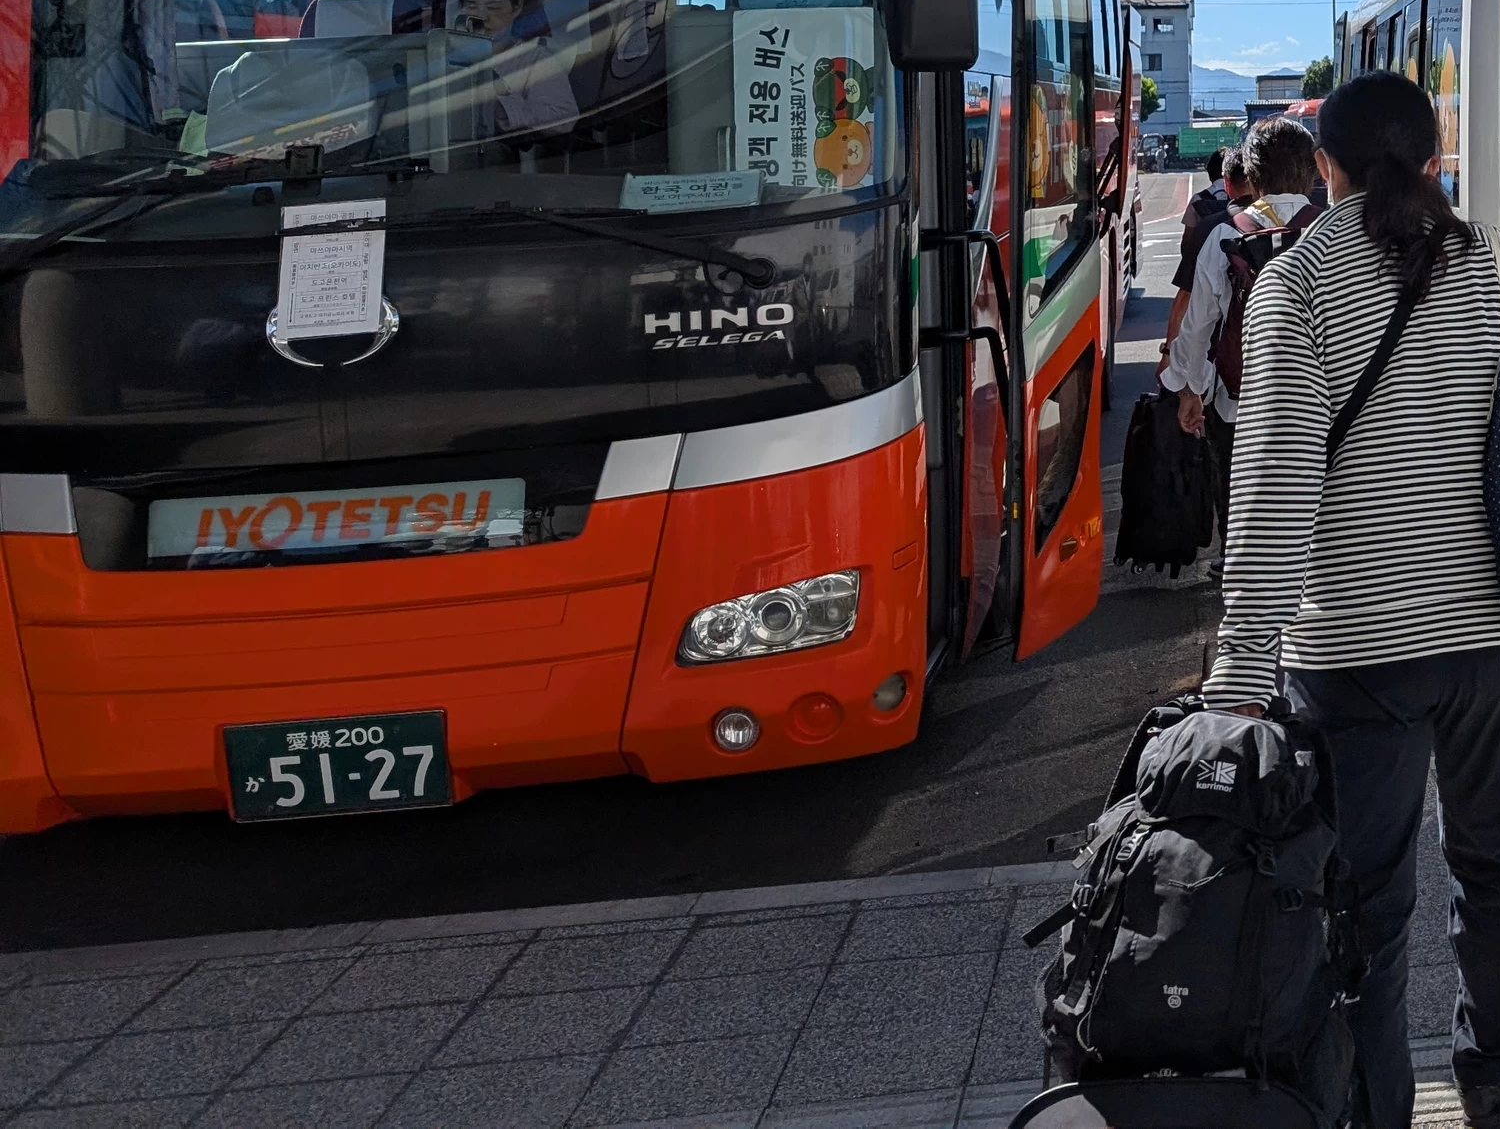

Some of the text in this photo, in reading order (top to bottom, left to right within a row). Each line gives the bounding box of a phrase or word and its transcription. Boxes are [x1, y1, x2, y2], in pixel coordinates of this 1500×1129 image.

[748, 26, 790, 186] 행객 전용 버스
[642, 186, 682, 195] 한국
[644, 303, 794, 334] HINO
[196, 490, 492, 550] IYOTETSU
[286, 726, 384, 752] 愛媛 200
[245, 745, 434, 808] か 51-27
[1196, 781, 1234, 792] karrimor
[1163, 984, 1189, 996] tatra
